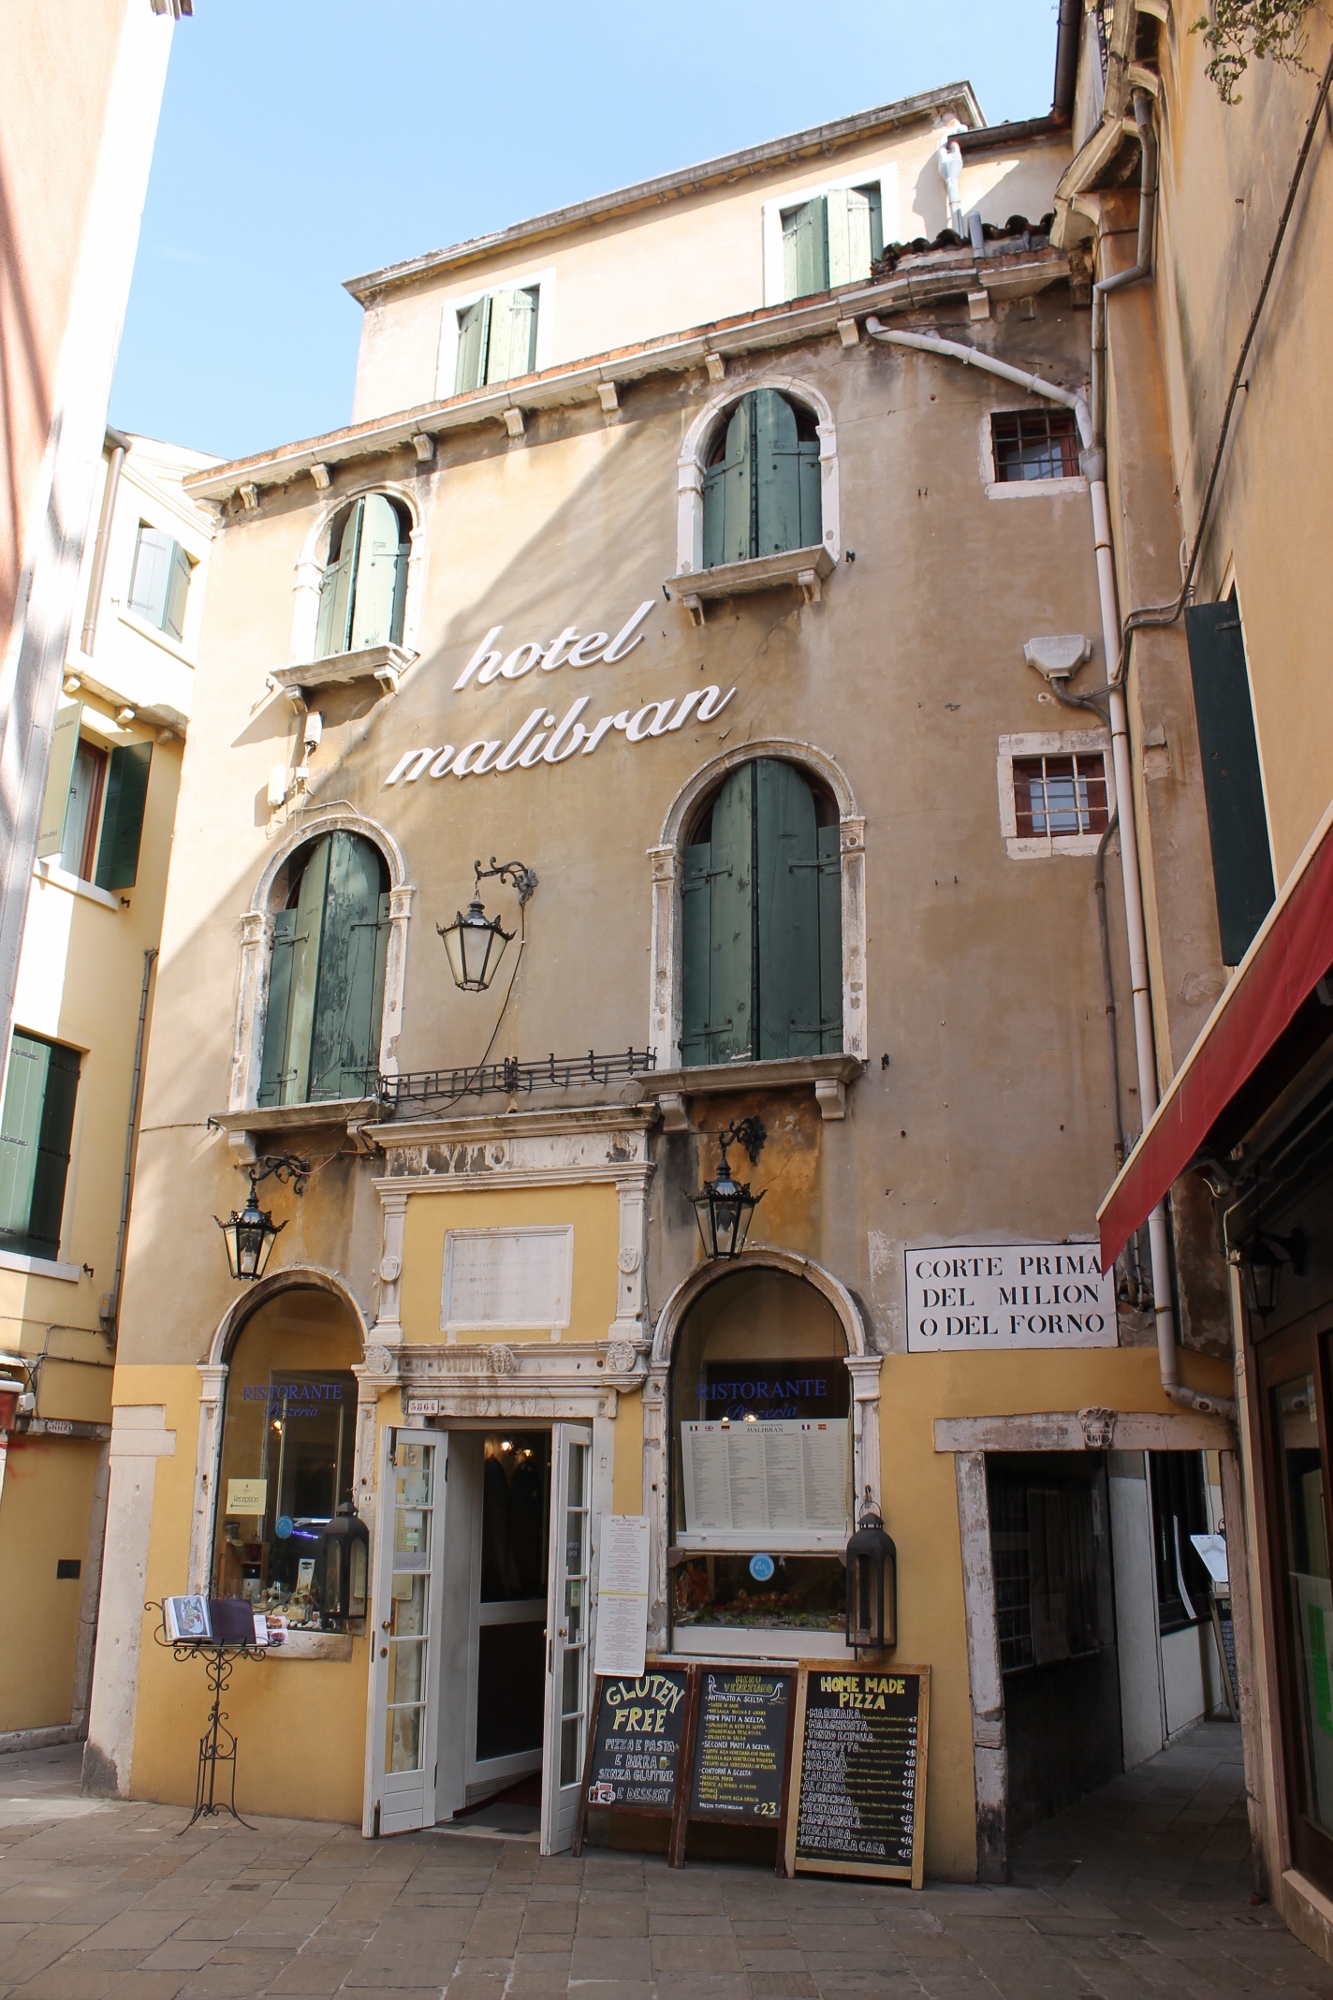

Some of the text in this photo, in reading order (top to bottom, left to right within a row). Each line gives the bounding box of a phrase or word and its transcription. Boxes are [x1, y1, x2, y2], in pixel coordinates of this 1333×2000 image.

[452, 600, 657, 692] hotel
[384, 685, 737, 786] malibran
[915, 1255, 1103, 1280] CORTE PRIMA
[922, 1284, 1100, 1308] DEL MILION
[919, 1313, 1105, 1337] O DEL FORNO
[243, 1384, 343, 1401] RISTORANTE
[697, 1379, 827, 1401] RISTORANTE
[262, 1401, 320, 1418] Pizzeria
[411, 1402, 435, 1412] 5864
[725, 1402, 798, 1420] Pizzeria
[233, 1495, 259, 1503] Reception
[735, 1676, 762, 1684] MENU
[820, 1676, 906, 1694] HOME MADE
[605, 1675, 685, 1714] GLUTEN
[839, 1692, 886, 1710] PIZZA
[612, 1707, 667, 1733] FREE
[809, 1708, 861, 1719] MARINARA
[808, 1718, 869, 1731] MARGHERITA
[605, 1738, 675, 1753] PIZZA E PASTA
[807, 1739, 860, 1753] PROSCIUTTO
[615, 1754, 657, 1768] E BIRRA
[806, 1750, 846, 1761] DIAVOLA
[805, 1760, 848, 1772] ROMANA
[598, 1768, 631, 1781] SENZA
[803, 1771, 845, 1783] CALZONE
[617, 1788, 624, 1799] E
[626, 1787, 671, 1801] DESSERT
[800, 1813, 861, 1828] CAMPAGNOLA
[800, 1824, 851, 1839] PESCATORA
[800, 1835, 827, 1848] PIZZA
[828, 1838, 858, 1852] DELLA
[859, 1841, 886, 1855] CASA
